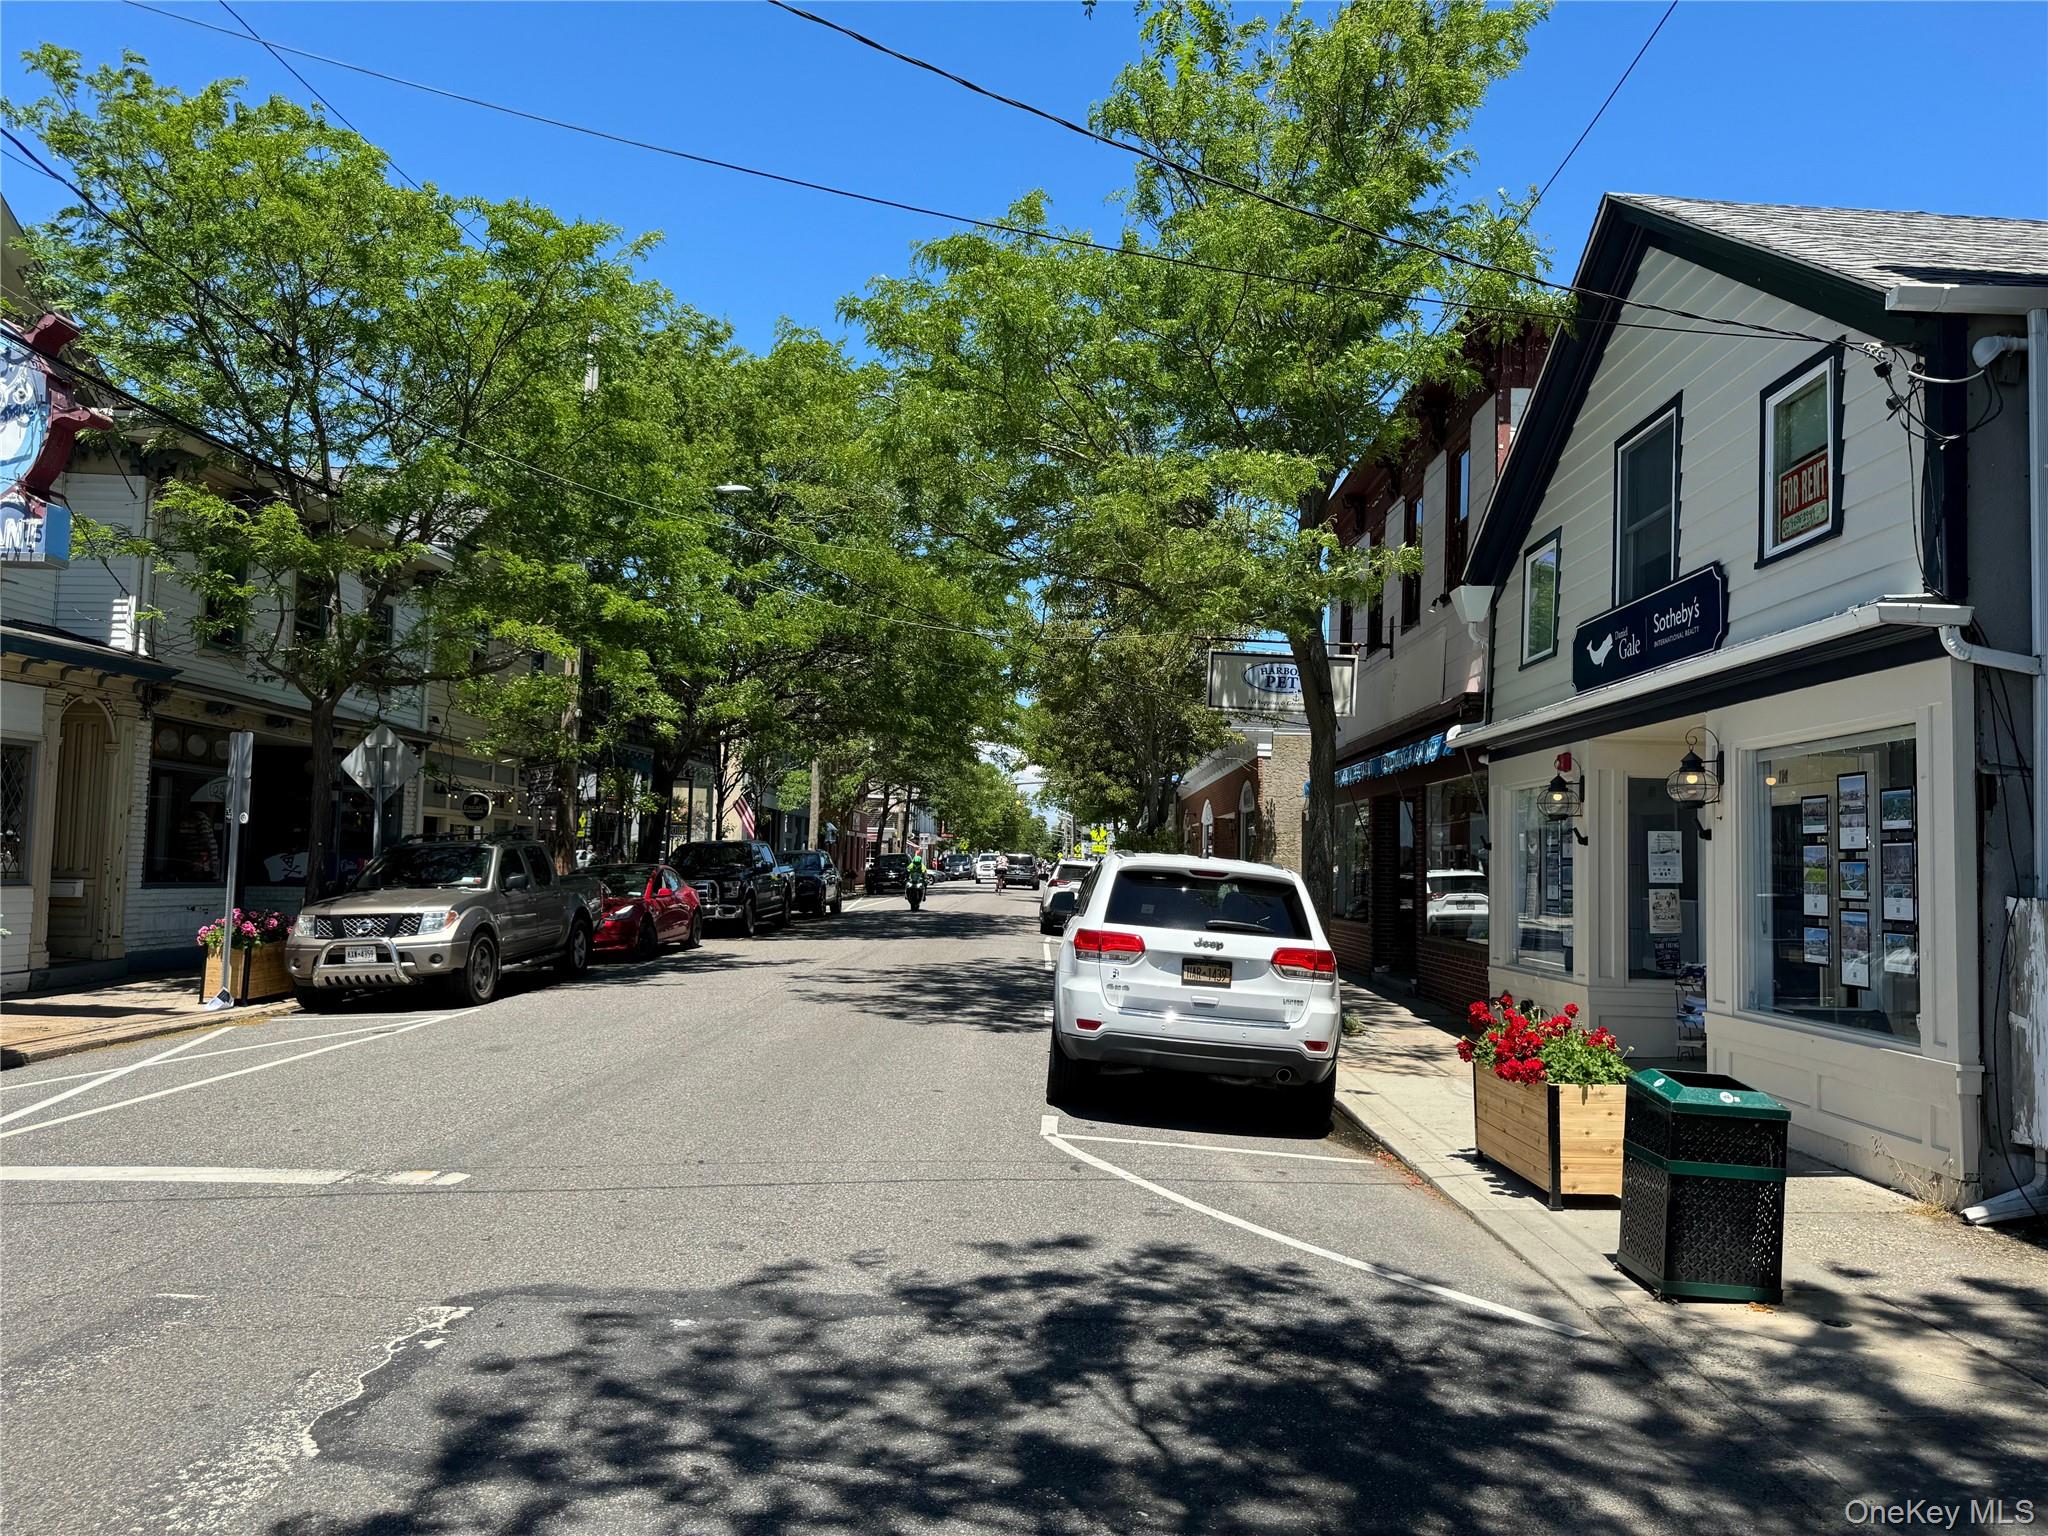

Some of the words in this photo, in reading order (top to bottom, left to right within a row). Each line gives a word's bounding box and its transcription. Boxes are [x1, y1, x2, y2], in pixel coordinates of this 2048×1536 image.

[1782, 474, 1799, 515] FOR
[1801, 459, 1826, 505] RENT
[1653, 596, 1700, 633] Sotheby's
[1614, 626, 1629, 640] Daniel
[1653, 631, 1684, 648] INTERNATIONAL
[1684, 626, 1700, 637] REALTY
[1618, 633, 1641, 660] Gale
[1260, 667, 1300, 676] HARBO
[1193, 937, 1224, 951] Jeep
